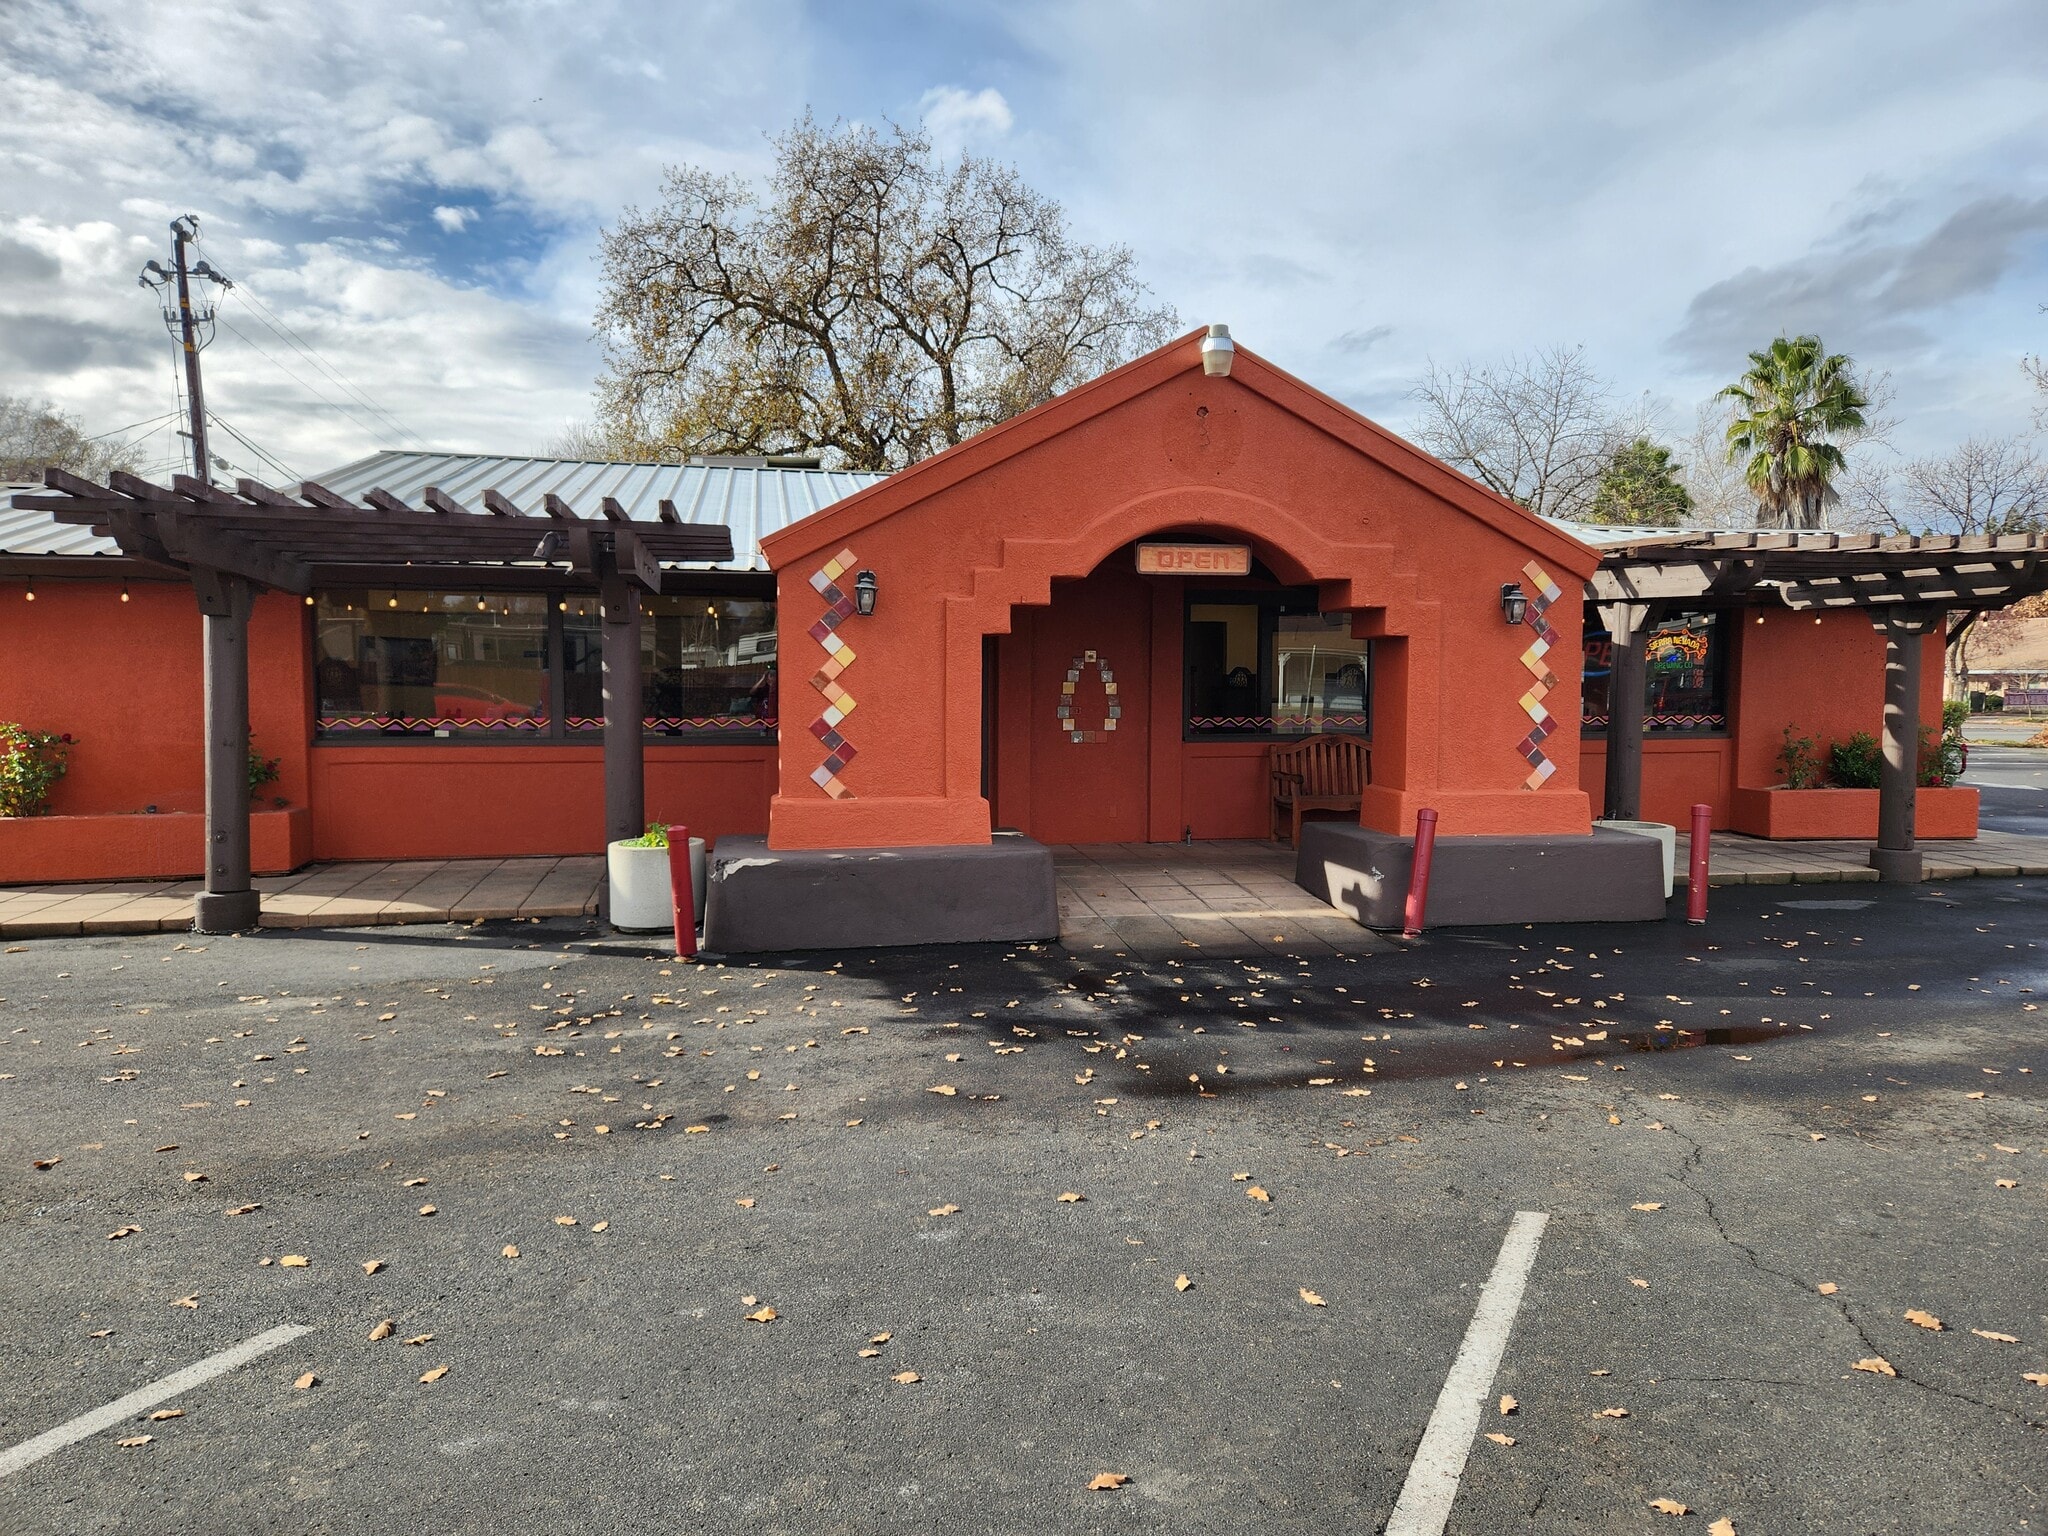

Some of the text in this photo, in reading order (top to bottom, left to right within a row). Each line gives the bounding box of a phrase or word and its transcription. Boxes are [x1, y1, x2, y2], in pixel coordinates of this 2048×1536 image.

[1157, 551, 1230, 569] OPEN
[1649, 636, 1700, 650] SIERRA NEVADA
